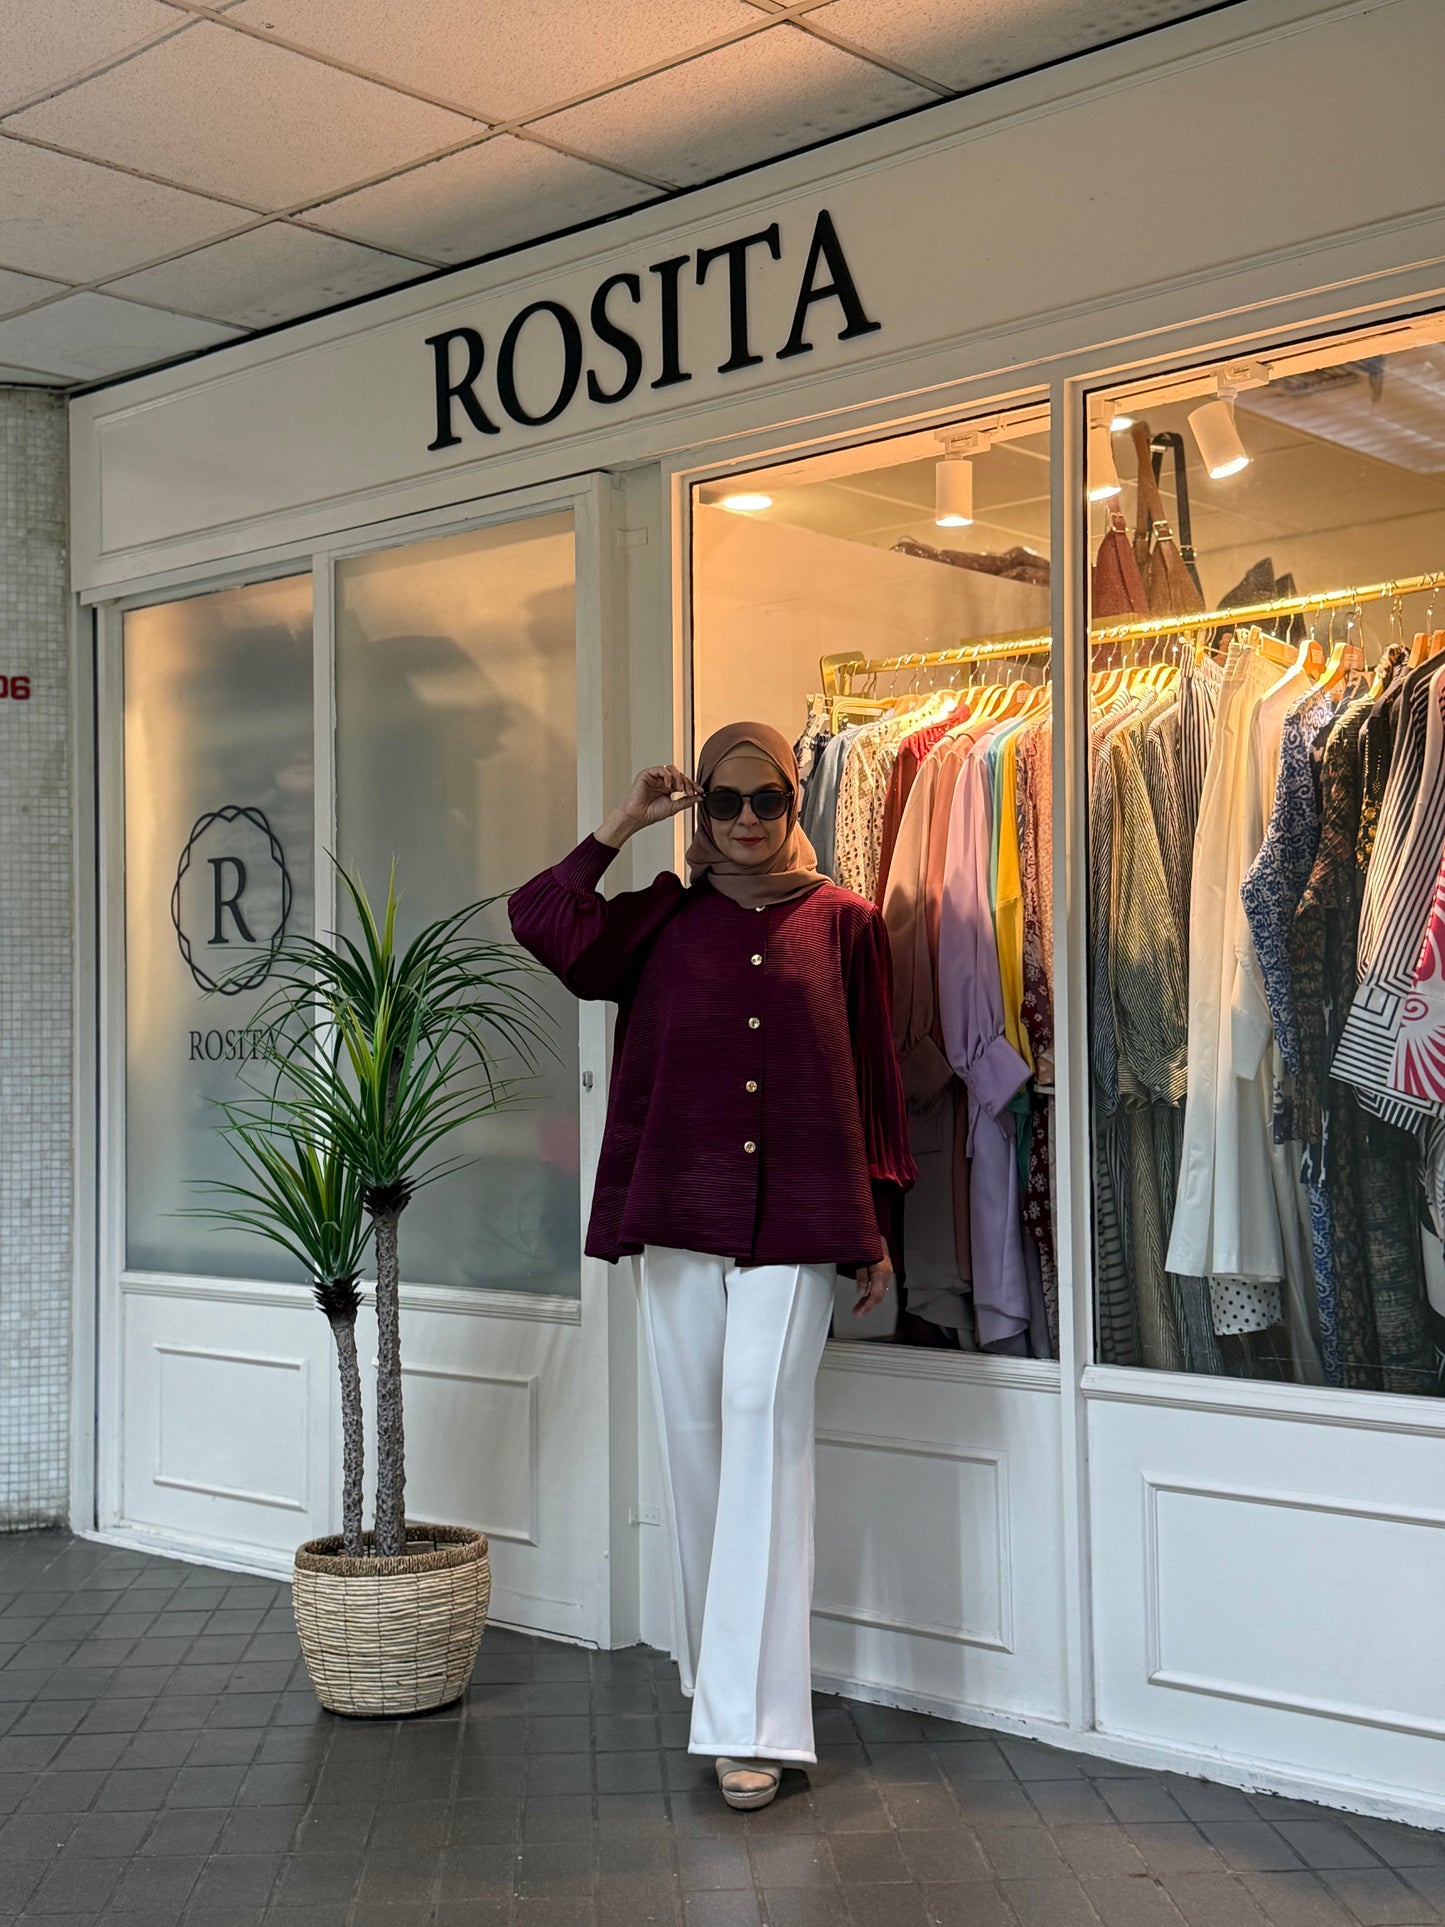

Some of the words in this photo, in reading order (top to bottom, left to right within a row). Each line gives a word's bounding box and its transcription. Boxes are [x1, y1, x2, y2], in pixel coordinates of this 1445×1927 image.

[424, 208, 882, 452] ROSITA
[207, 856, 257, 945] R
[188, 1029, 277, 1061] ROSITA
